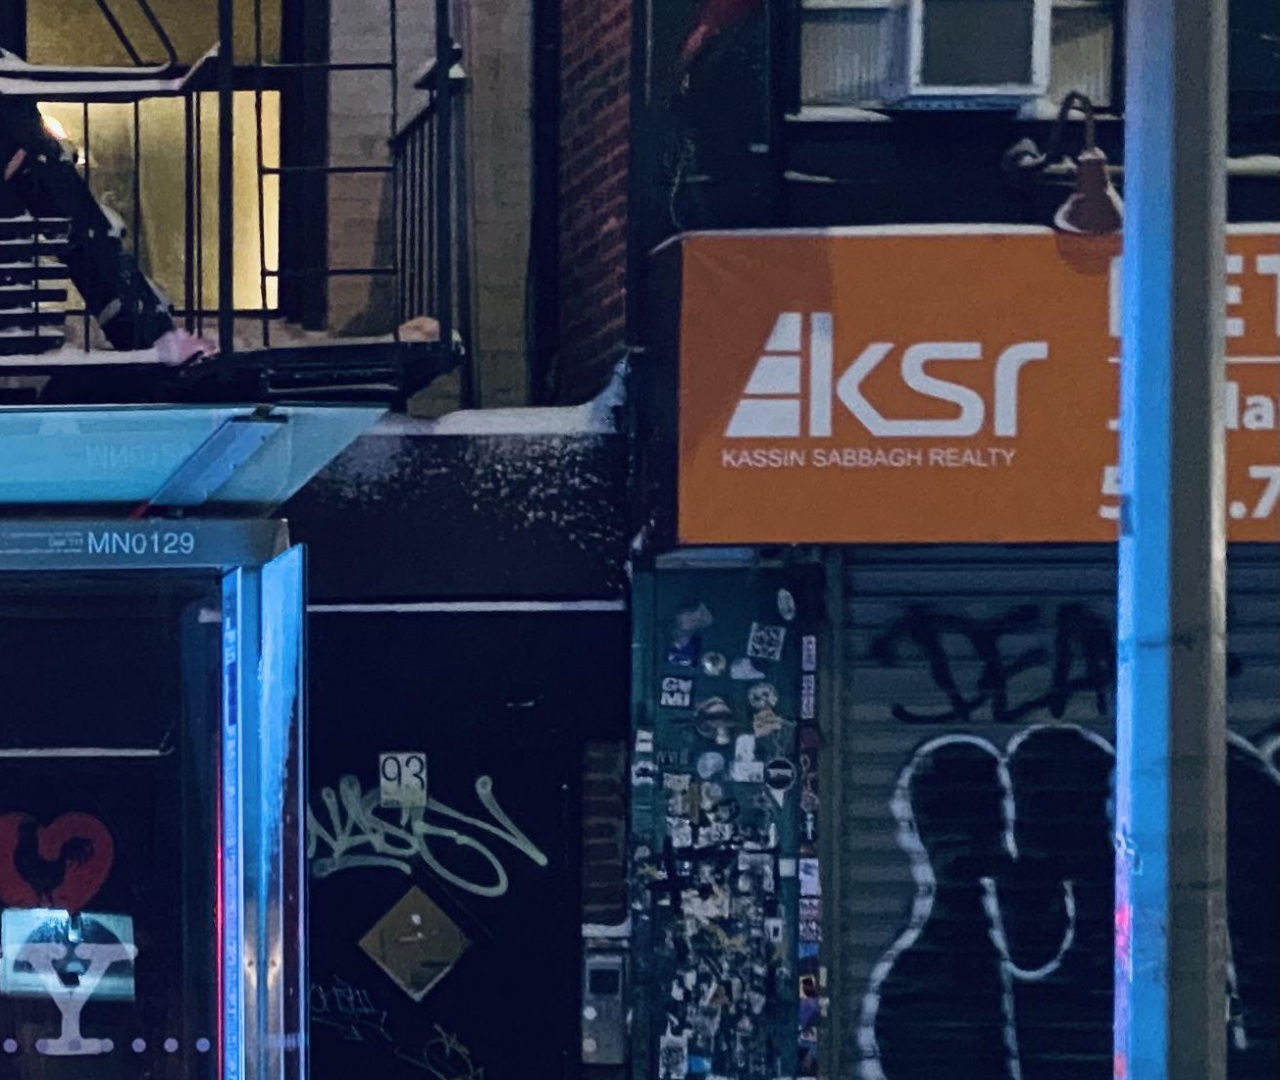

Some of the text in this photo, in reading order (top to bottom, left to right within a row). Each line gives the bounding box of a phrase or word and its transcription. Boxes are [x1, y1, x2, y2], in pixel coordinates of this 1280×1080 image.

[722, 449, 1017, 467] KASSIN SABBAGH REALTY
[87, 531, 195, 555] MN0129
[381, 755, 425, 789] 93
